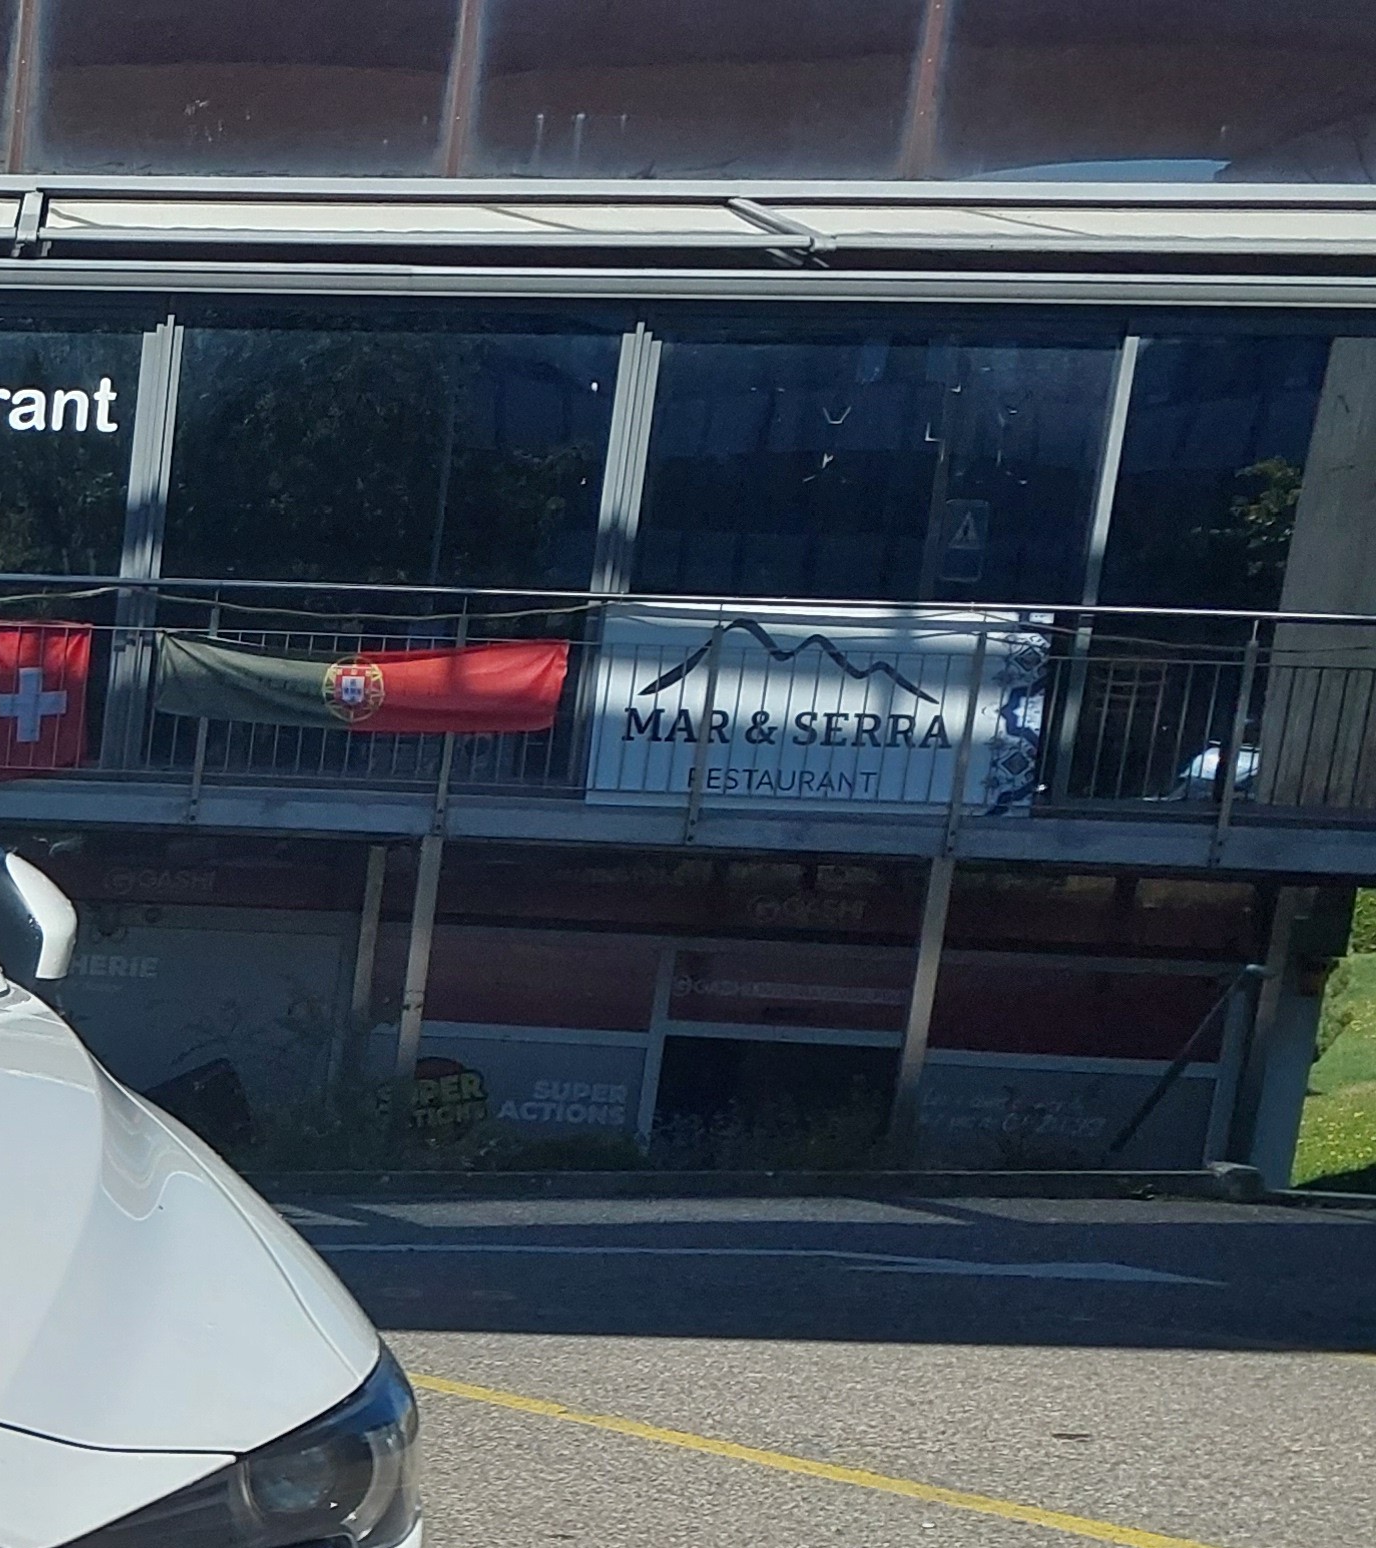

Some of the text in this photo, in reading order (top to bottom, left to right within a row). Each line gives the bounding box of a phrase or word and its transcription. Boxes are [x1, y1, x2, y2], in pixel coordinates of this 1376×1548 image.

[622, 708, 952, 750] MAR & SERRA
[534, 1079, 628, 1104] SUPER
[498, 1101, 625, 1125] ACTIONS
